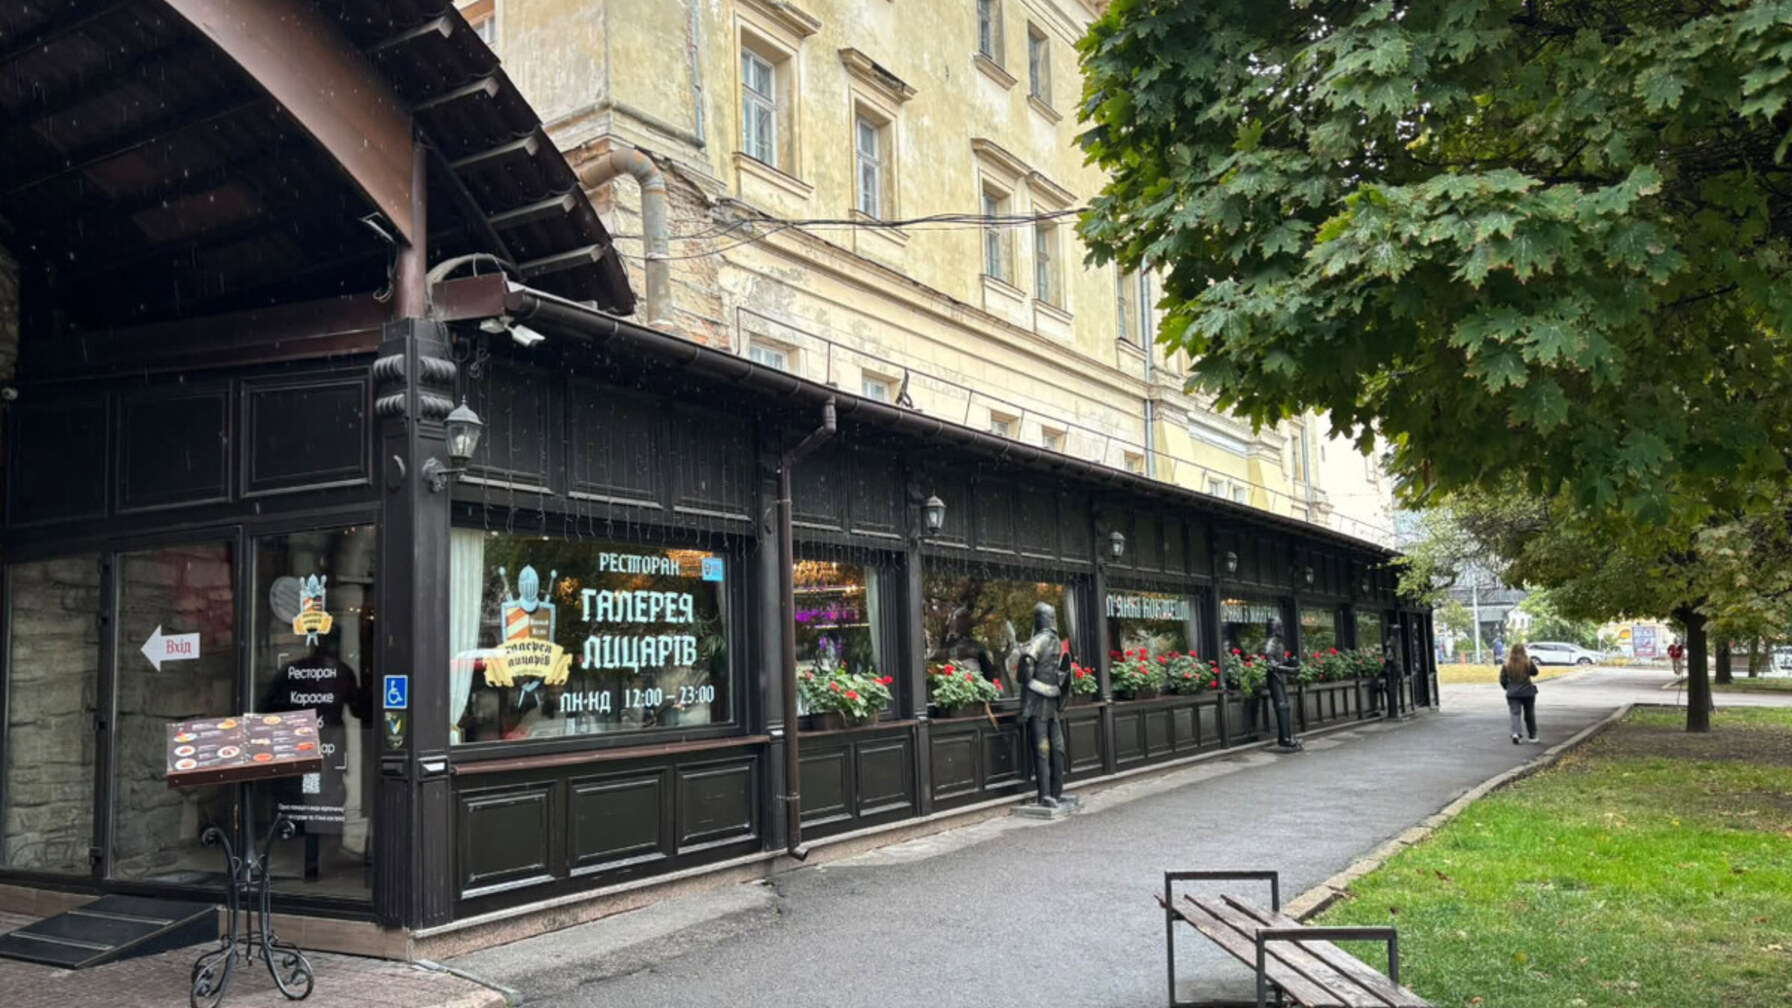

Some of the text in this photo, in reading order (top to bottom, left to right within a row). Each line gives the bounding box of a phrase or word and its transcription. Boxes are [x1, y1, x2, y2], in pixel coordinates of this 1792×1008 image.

[599, 552, 680, 576] РЕСТОРАН
[581, 587, 694, 623] ГАЛЕРЕЯ
[166, 639, 192, 655] Вхід
[581, 635, 697, 672] ЛИЦАРІВ
[288, 666, 337, 682] Ресторан
[290, 691, 334, 707] Караоке
[624, 688, 662, 709] 12:00
[680, 685, 715, 706] 23:00
